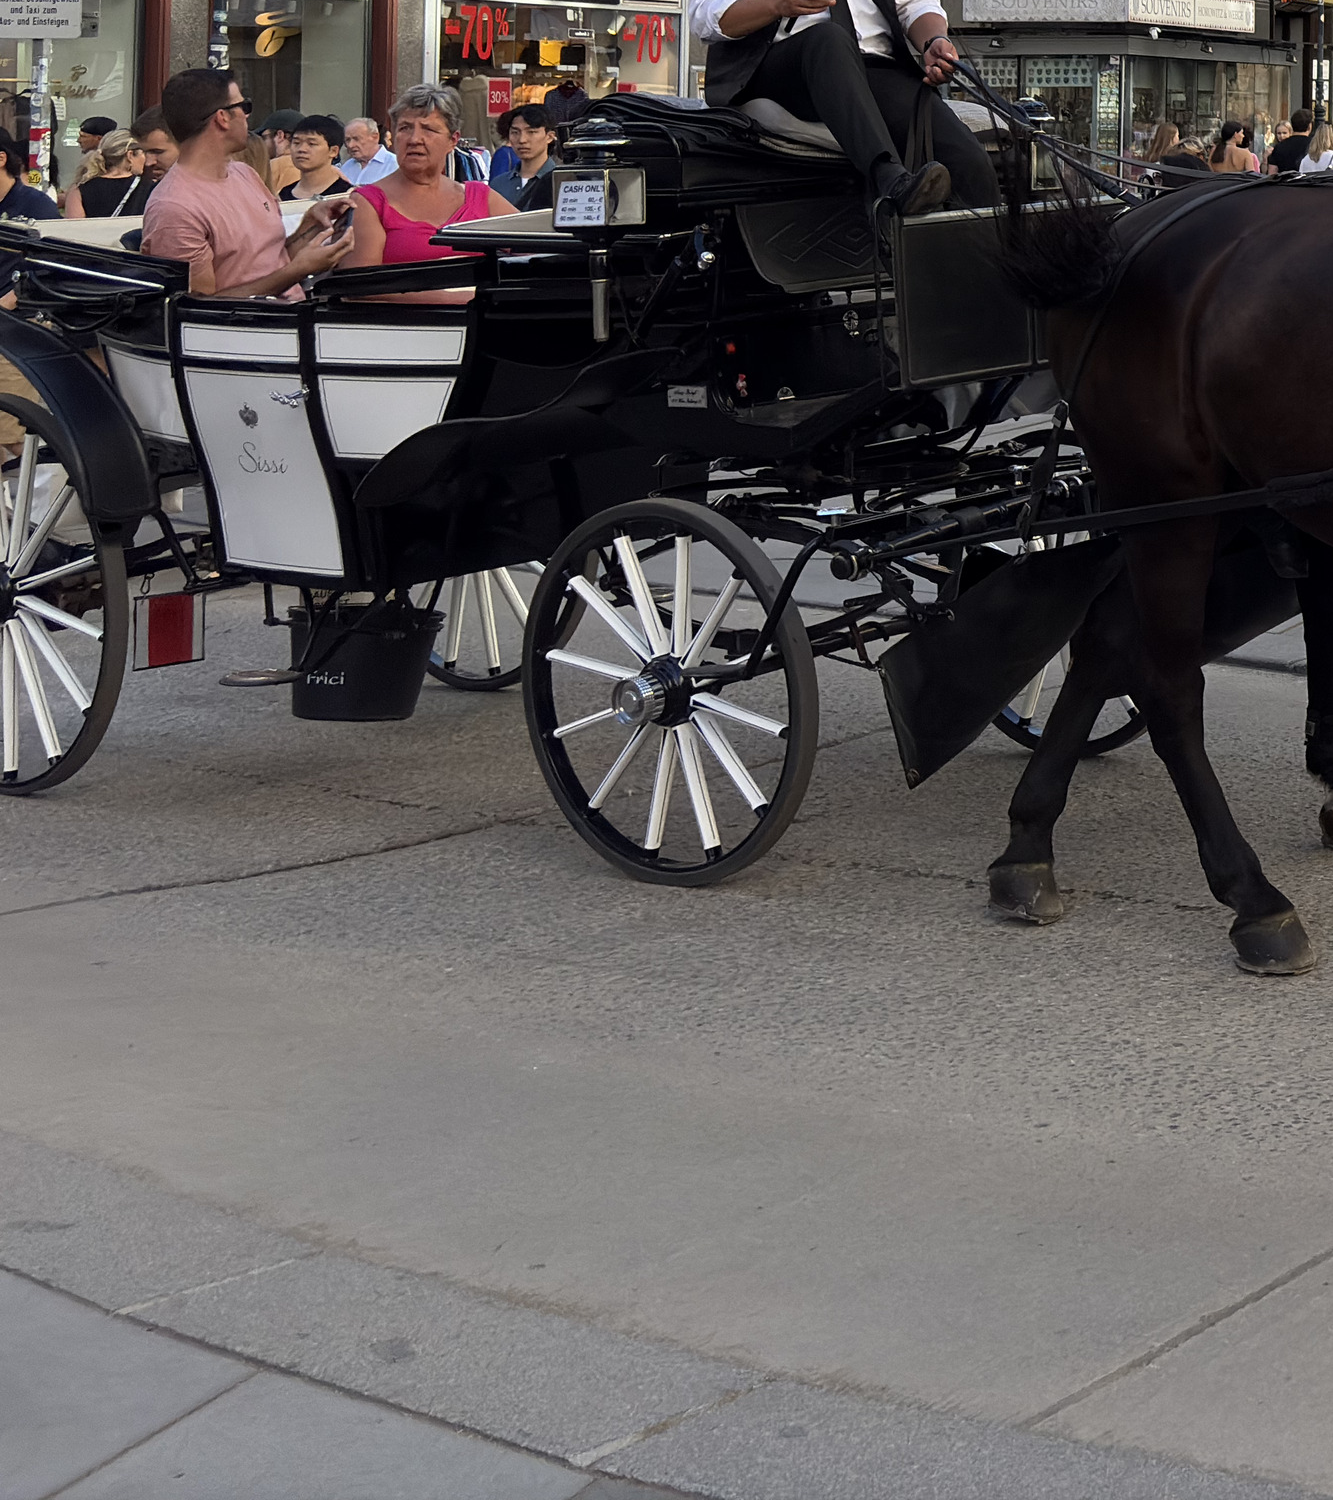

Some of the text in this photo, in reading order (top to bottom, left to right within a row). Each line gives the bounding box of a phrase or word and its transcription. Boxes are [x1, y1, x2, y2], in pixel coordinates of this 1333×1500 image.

[10, 6, 23, 14] und
[33, 17, 69, 28] Einsteigen
[490, 90, 509, 104] 30%
[563, 185, 583, 194] CASH
[238, 441, 289, 474] Sissi
